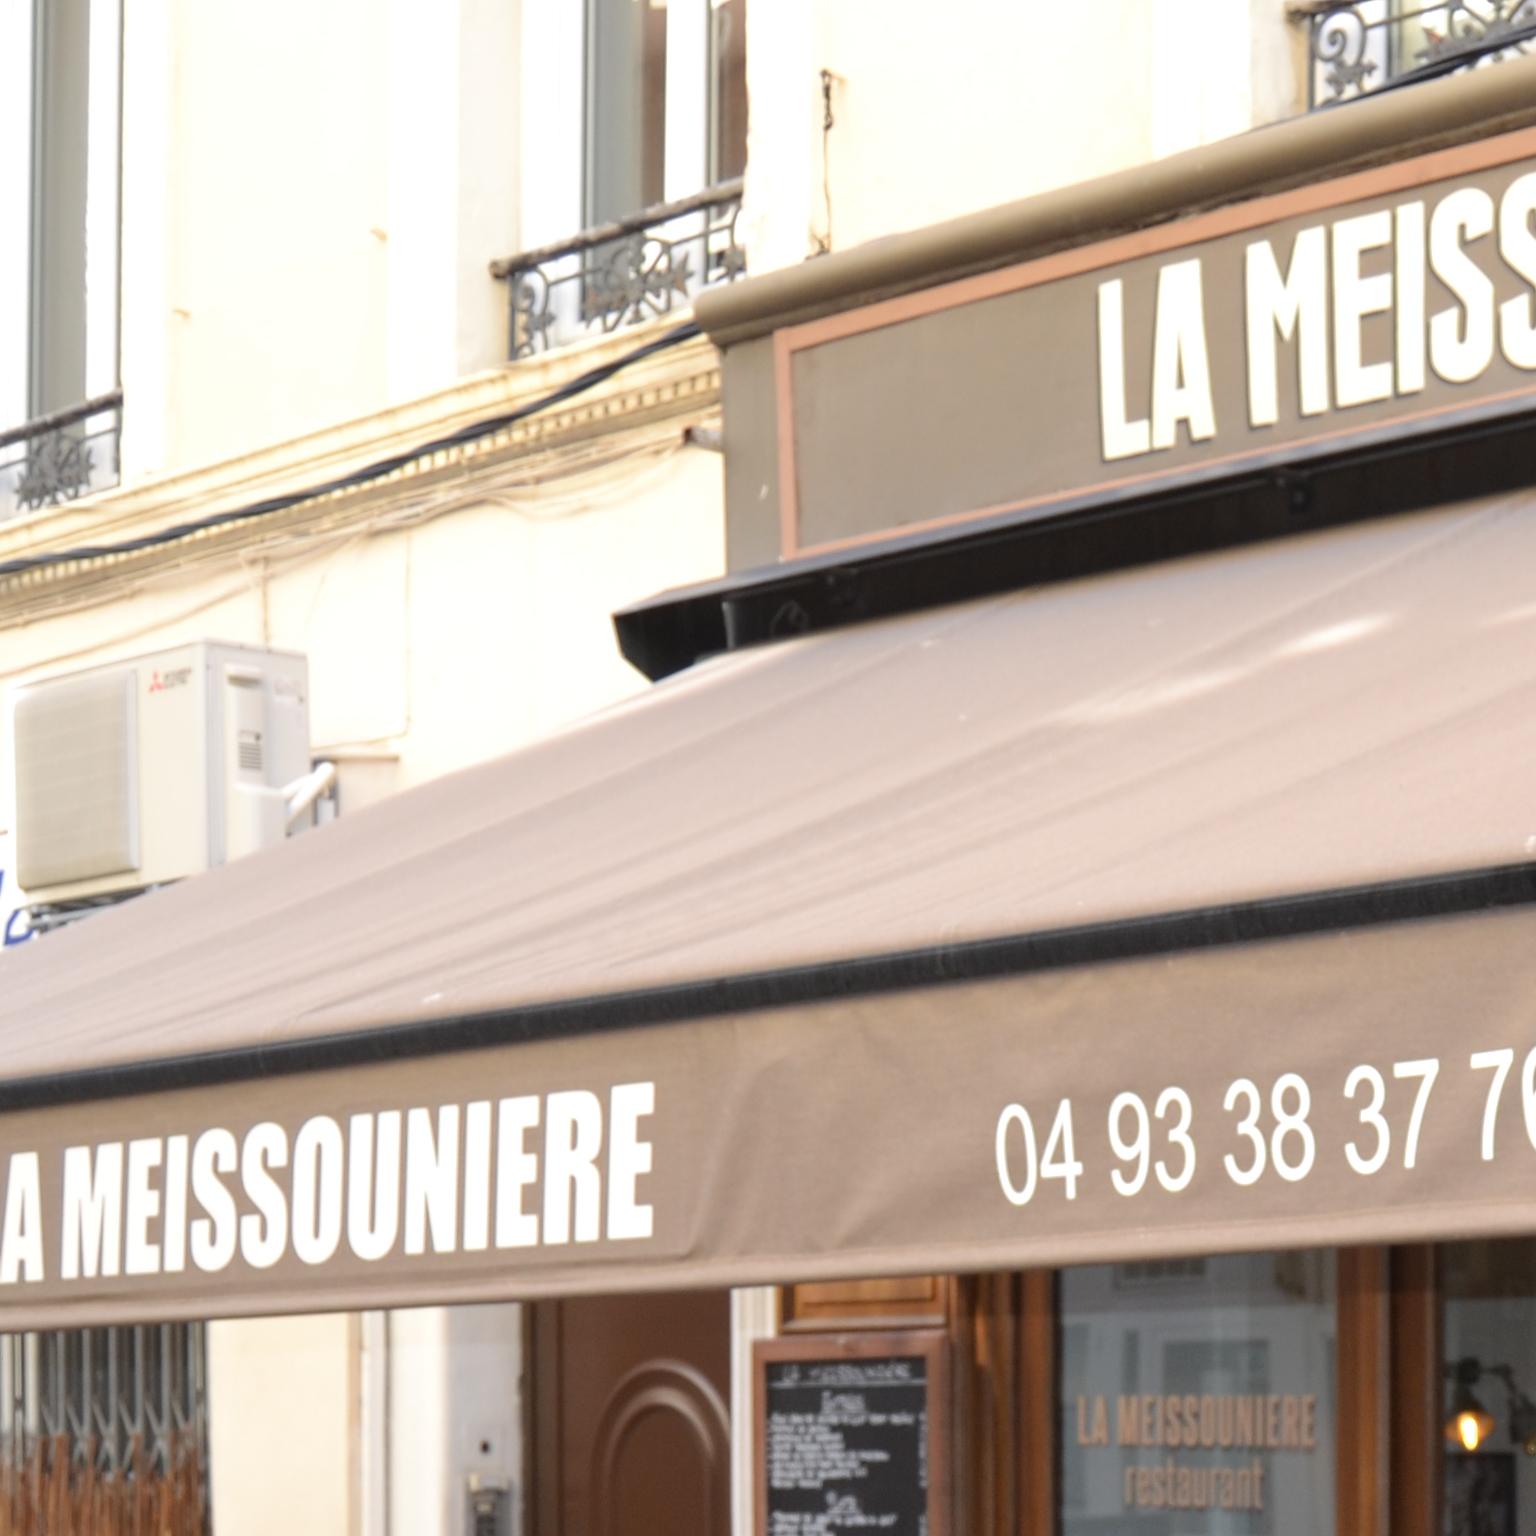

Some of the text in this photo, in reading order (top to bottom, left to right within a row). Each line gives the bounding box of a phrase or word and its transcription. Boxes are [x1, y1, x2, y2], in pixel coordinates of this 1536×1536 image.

[1098, 257, 1216, 462] LA
[61, 1081, 656, 1280] MEISSOUNIERE
[995, 1098, 1083, 1206] 04
[1108, 1086, 1197, 1197] 93
[1223, 1073, 1316, 1186] 38
[1343, 1058, 1440, 1175] 37
[1076, 1392, 1317, 1449] LA MEISSOUNIERE
[1125, 1455, 1264, 1510] restaurant
